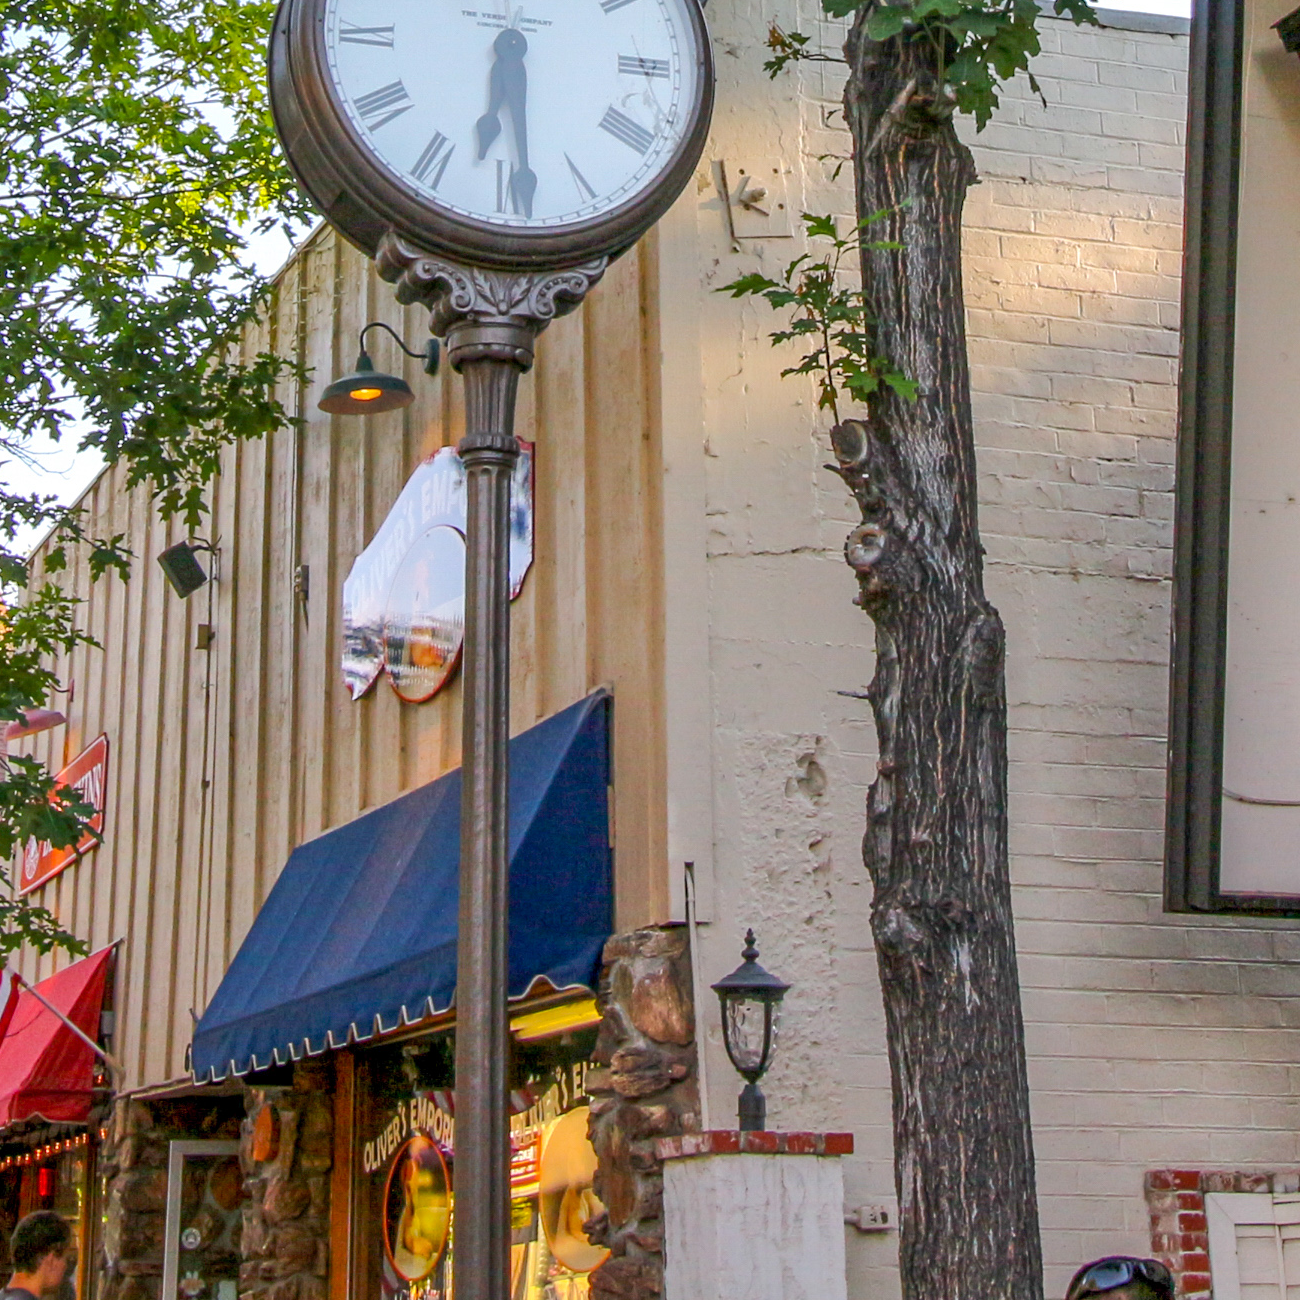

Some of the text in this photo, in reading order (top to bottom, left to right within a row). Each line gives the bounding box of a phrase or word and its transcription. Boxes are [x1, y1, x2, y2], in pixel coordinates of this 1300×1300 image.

[481, 12, 507, 20] VERDI
[519, 17, 553, 27] OMPANY
[363, 1101, 408, 1174] OLIVER'S
